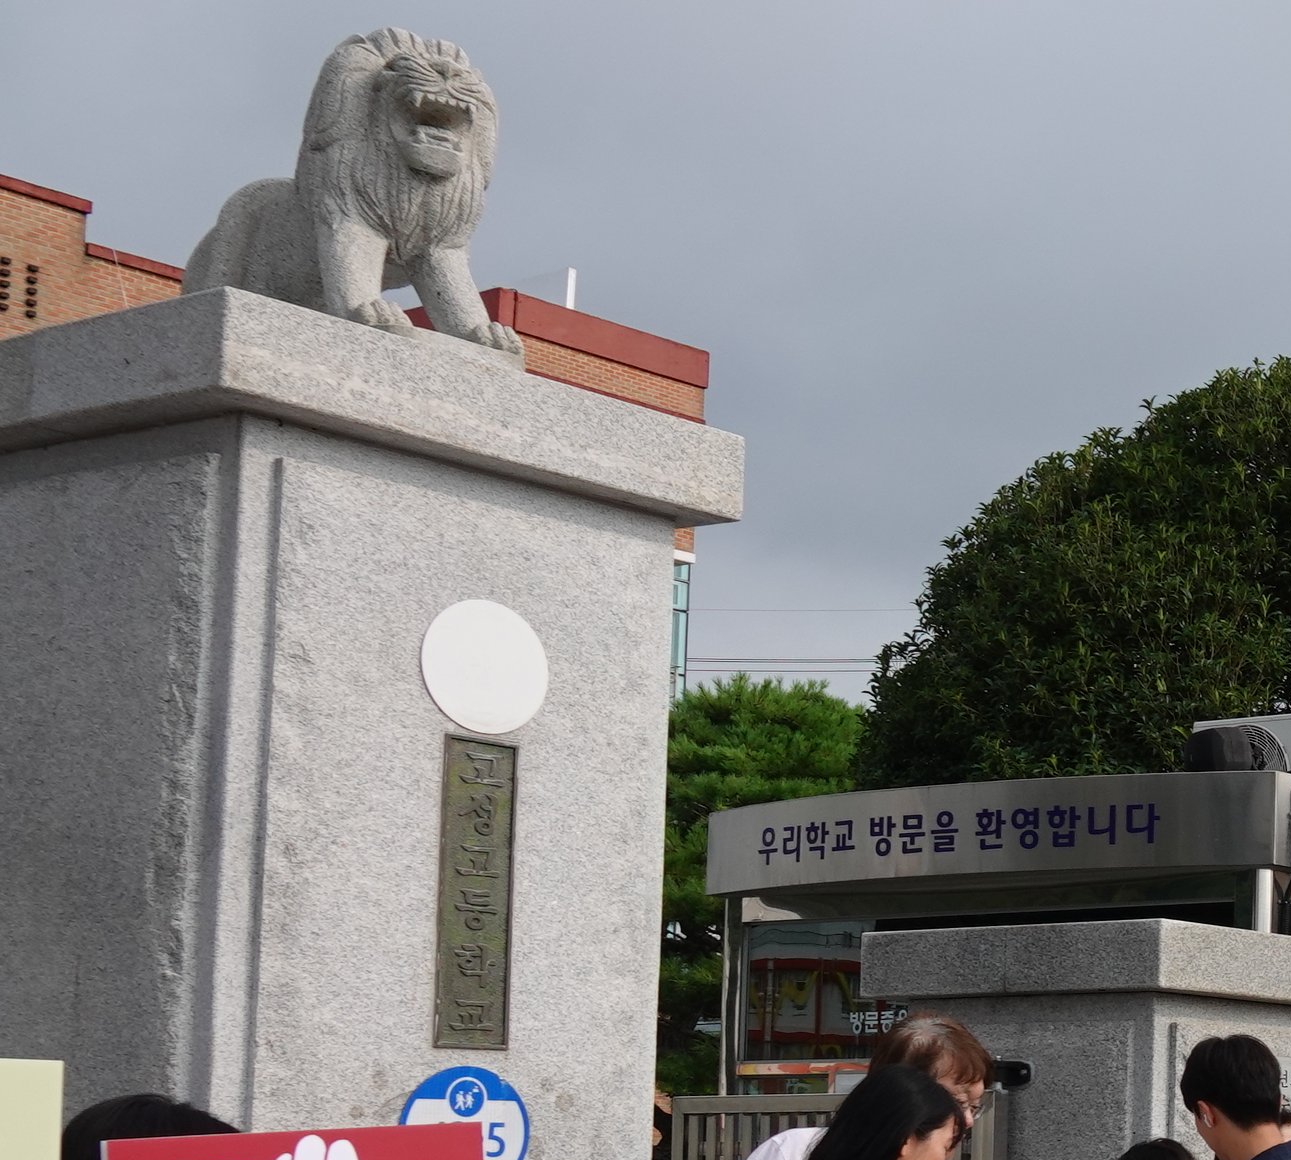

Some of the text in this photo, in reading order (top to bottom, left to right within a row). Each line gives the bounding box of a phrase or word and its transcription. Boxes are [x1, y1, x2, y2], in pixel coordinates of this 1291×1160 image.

[758, 803, 1160, 865] 우리학교 방문을 환영합니다
